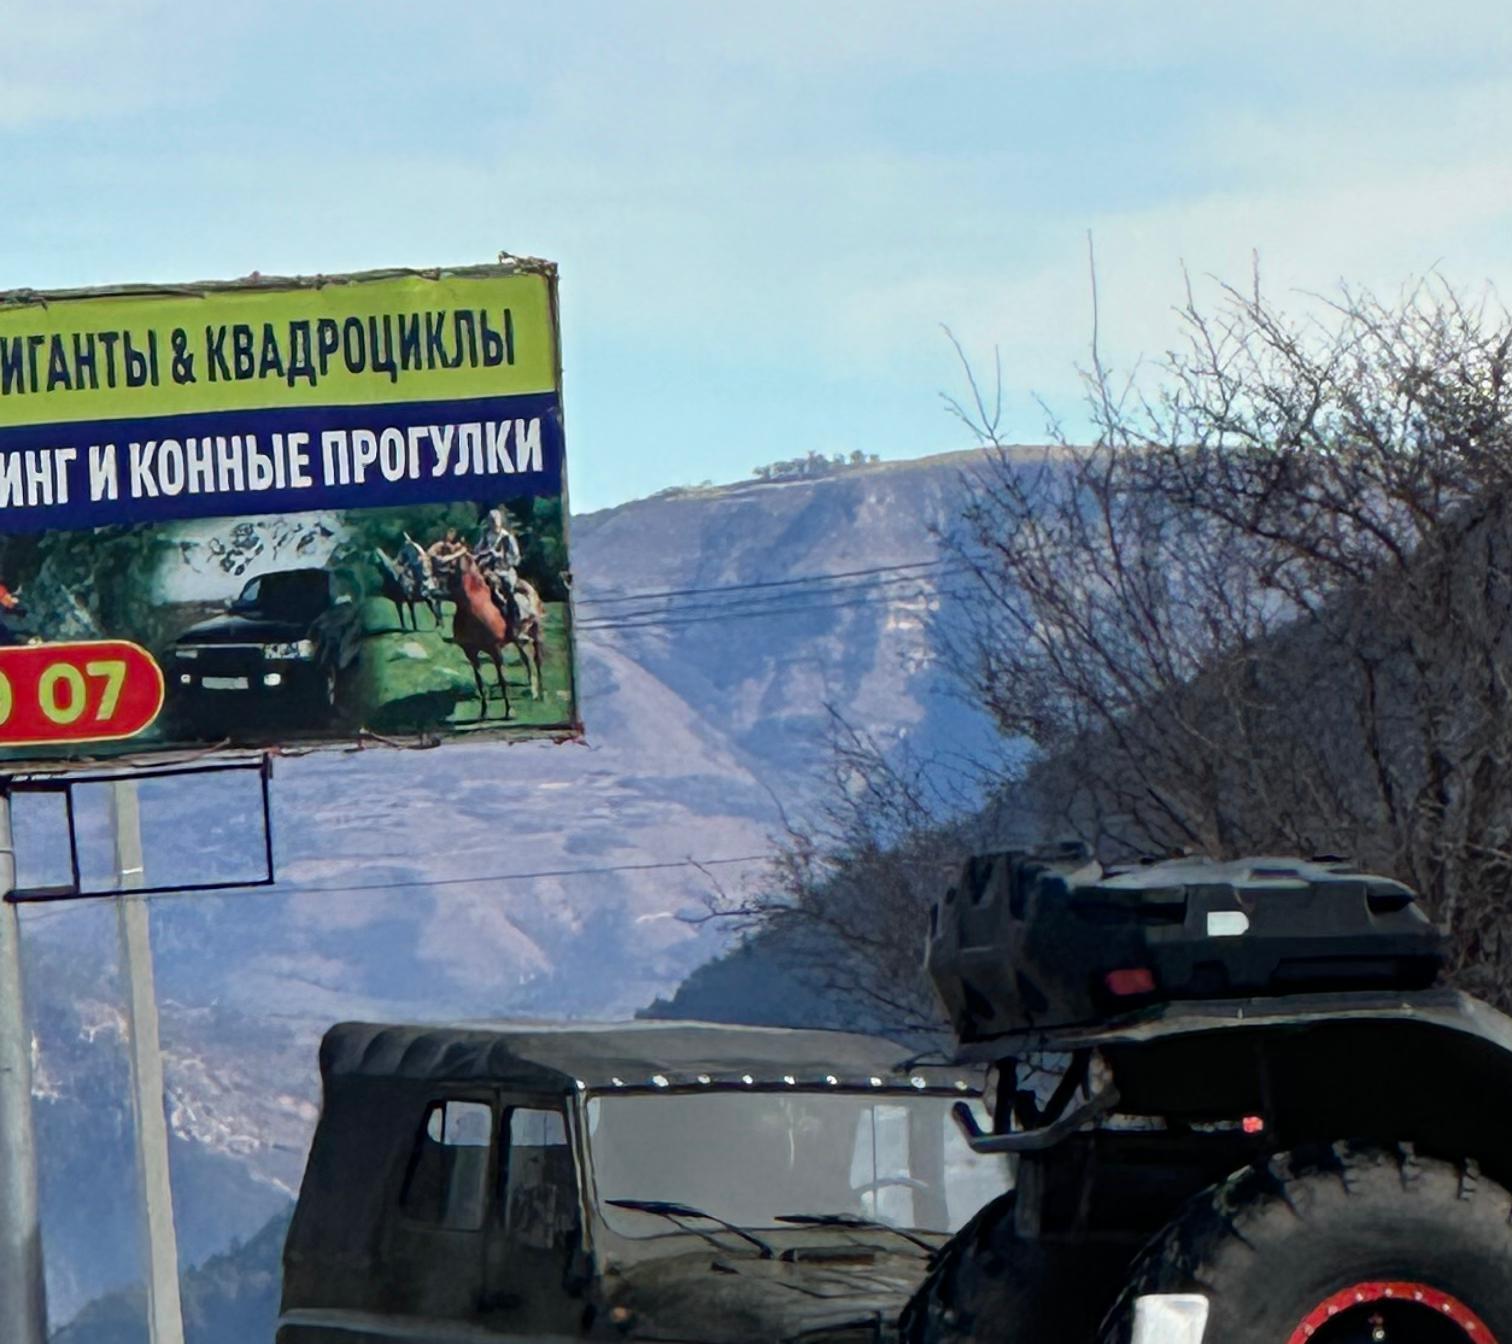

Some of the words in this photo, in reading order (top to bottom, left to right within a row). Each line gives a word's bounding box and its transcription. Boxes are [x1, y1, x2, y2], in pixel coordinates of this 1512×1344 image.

[0, 329, 160, 395] ИГАНТЫ
[171, 327, 197, 385] &
[205, 308, 515, 387] КВАДРОЦИКЛЫ
[88, 444, 119, 502] И
[129, 432, 313, 499] КОННЫЕ
[321, 417, 544, 487] ПРОГУЛКИ
[38, 660, 127, 725] 07
